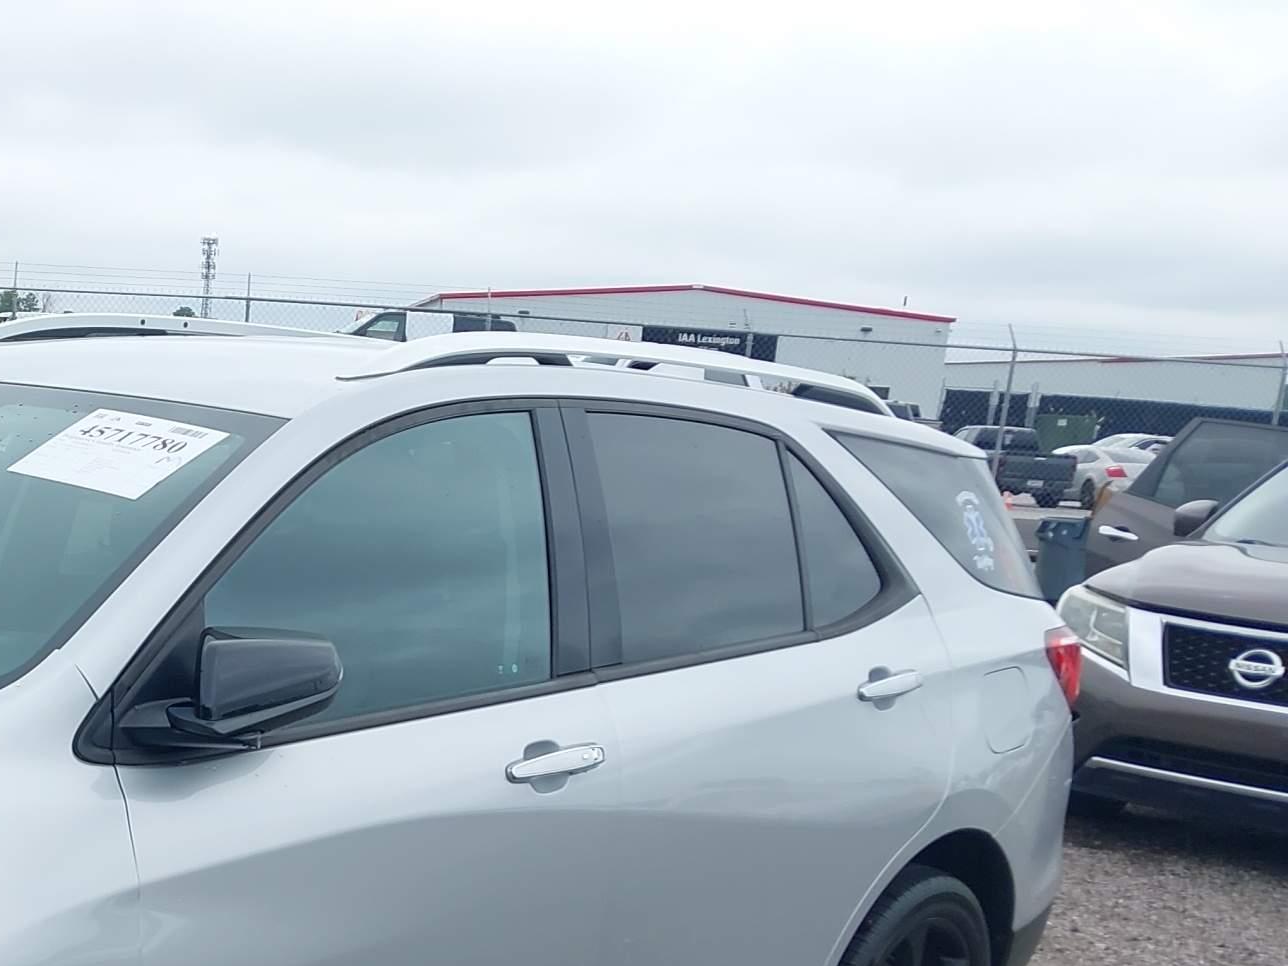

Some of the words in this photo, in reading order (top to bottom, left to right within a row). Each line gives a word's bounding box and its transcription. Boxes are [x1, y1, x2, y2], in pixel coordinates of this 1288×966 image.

[678, 333, 696, 343] IAA
[697, 333, 740, 345] Lexington
[79, 424, 188, 454] 45717780
